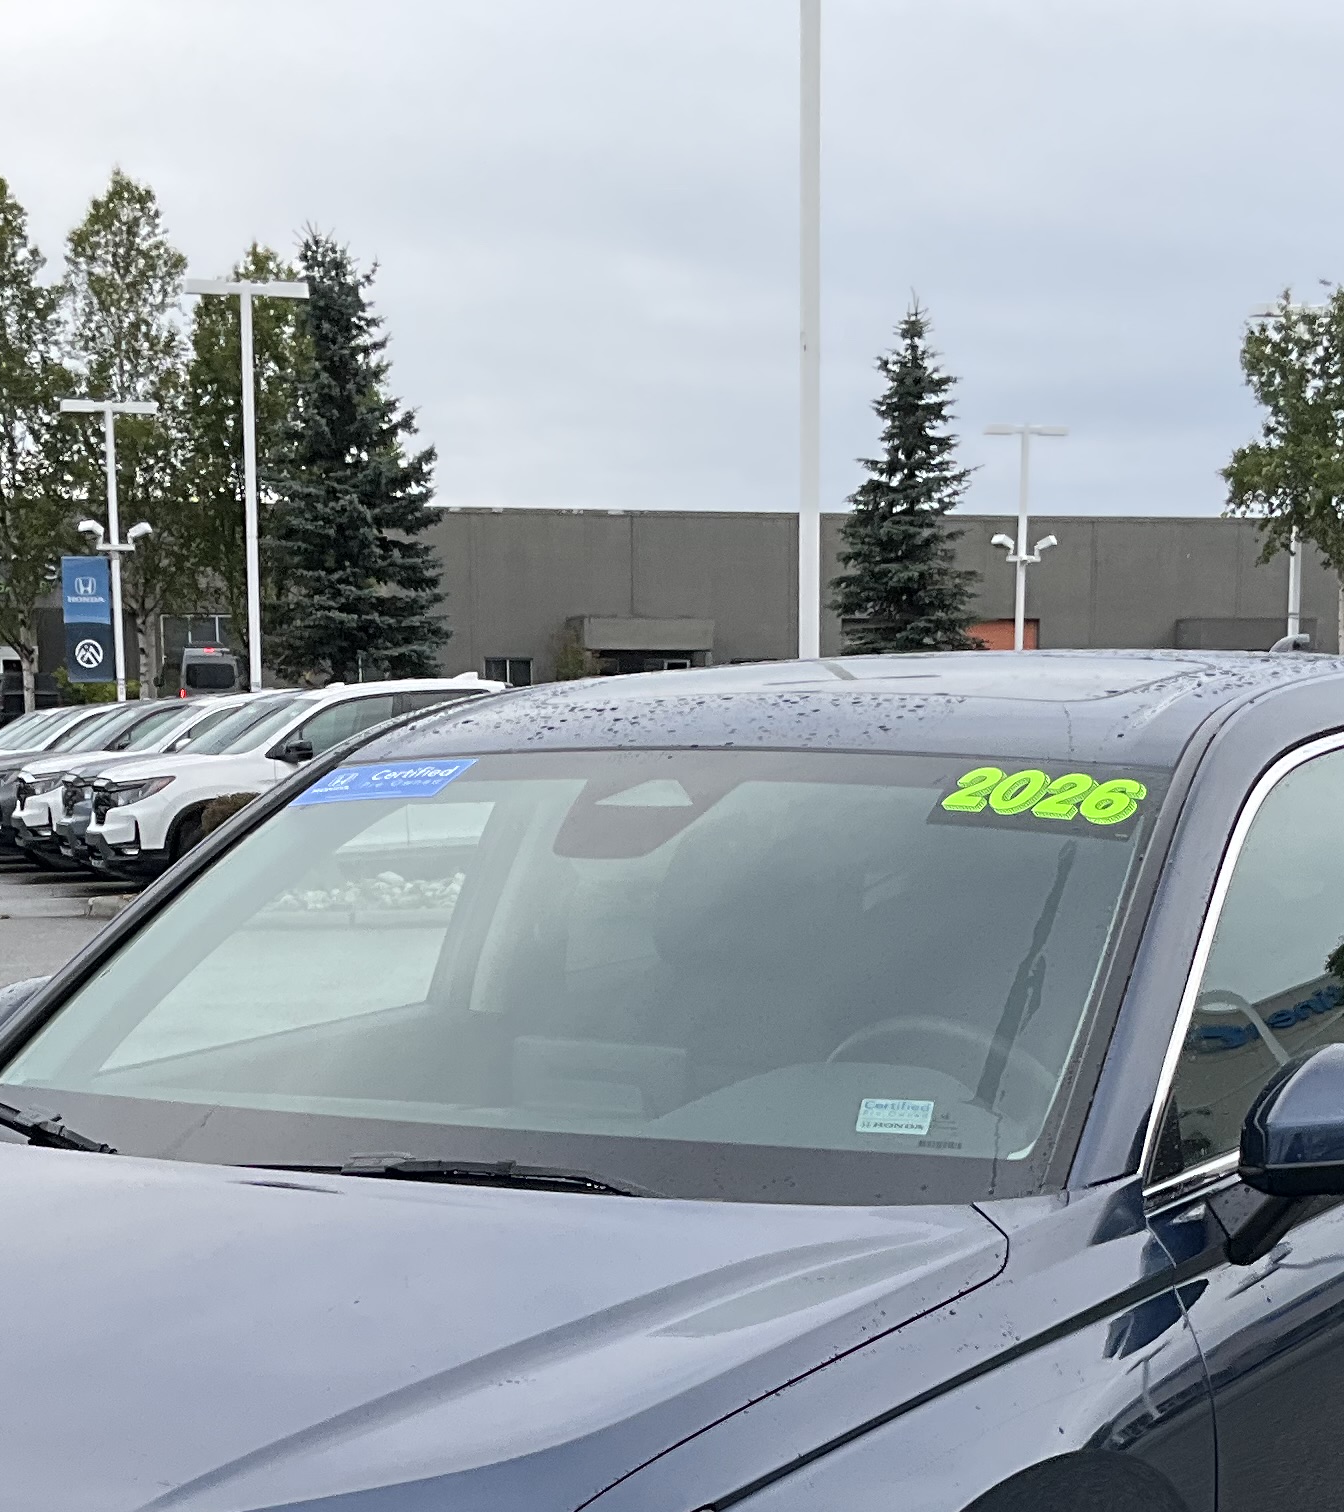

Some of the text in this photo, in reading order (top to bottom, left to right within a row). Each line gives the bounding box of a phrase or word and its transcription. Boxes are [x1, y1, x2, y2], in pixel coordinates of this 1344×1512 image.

[66, 595, 106, 603] HONDA
[371, 765, 460, 781] Certified
[941, 766, 1147, 826] 2026
[864, 1101, 932, 1112] Certified
[872, 1121, 924, 1131] HONDA
